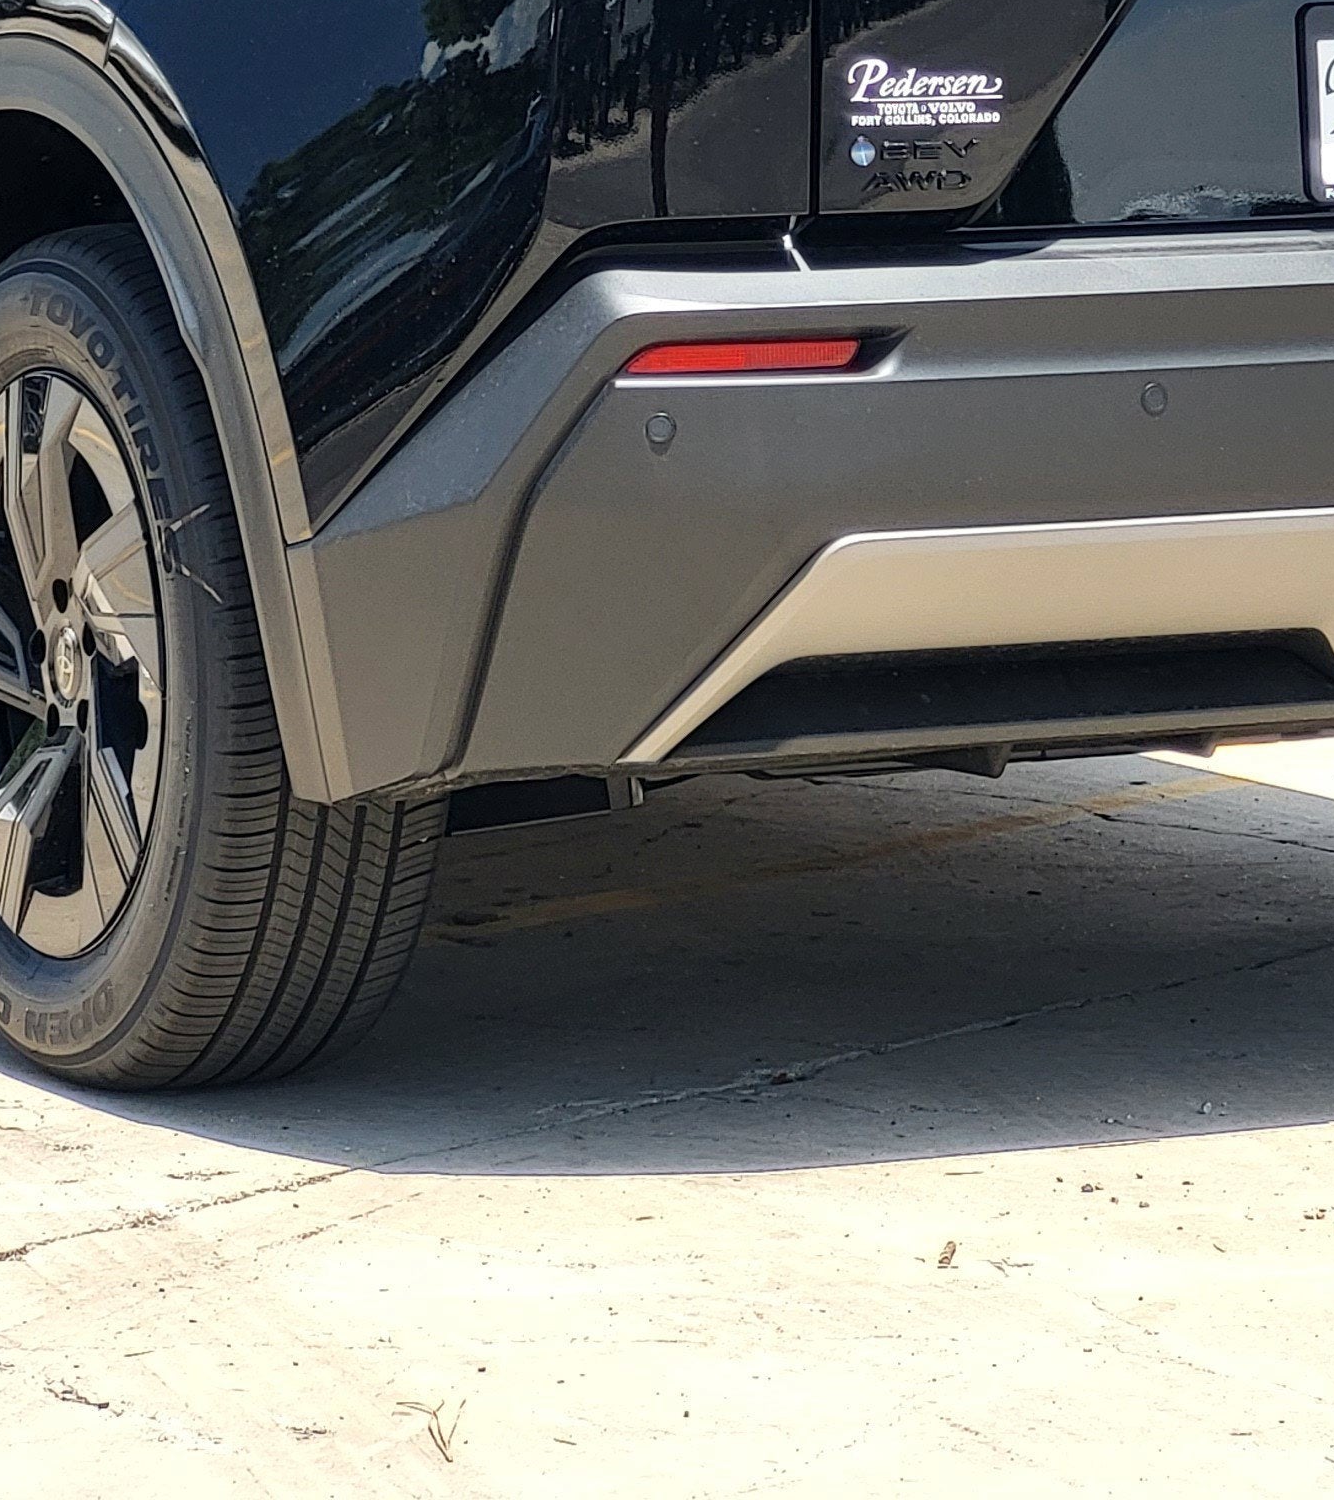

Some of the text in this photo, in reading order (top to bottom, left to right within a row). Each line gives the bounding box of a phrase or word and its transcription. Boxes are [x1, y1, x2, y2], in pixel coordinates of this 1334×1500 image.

[847, 58, 1004, 103] Pedersen
[851, 115, 883, 127] FORT
[938, 112, 1001, 125] COLORADO
[876, 101, 976, 115] TOYOTA VOLVO
[880, 137, 980, 161] BEV
[860, 169, 972, 192] AWD
[24, 978, 116, 1048] OPEN
